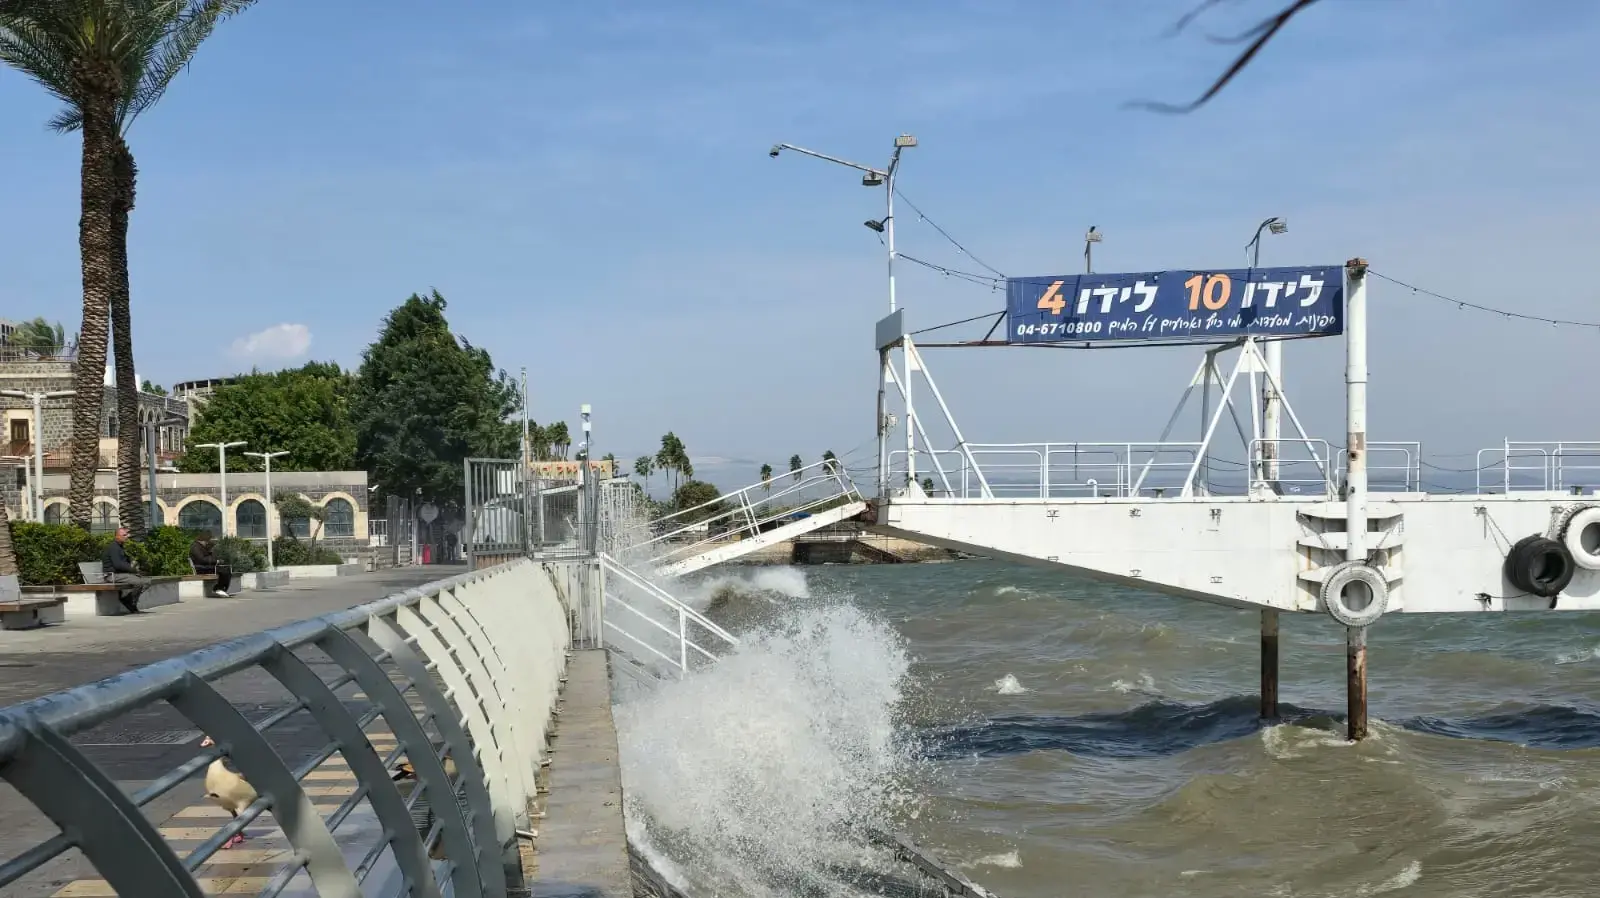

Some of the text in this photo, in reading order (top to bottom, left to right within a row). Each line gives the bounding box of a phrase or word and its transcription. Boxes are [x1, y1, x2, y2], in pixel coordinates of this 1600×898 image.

[1037, 274, 1324, 315] לידו 10 לידו 4
[1017, 321, 1102, 336] 04-6710800
[1109, 317, 1137, 335] המים
[1142, 314, 1158, 332] על
[1247, 312, 1293, 328] מסעדות
[1295, 313, 1336, 331] ספינות
